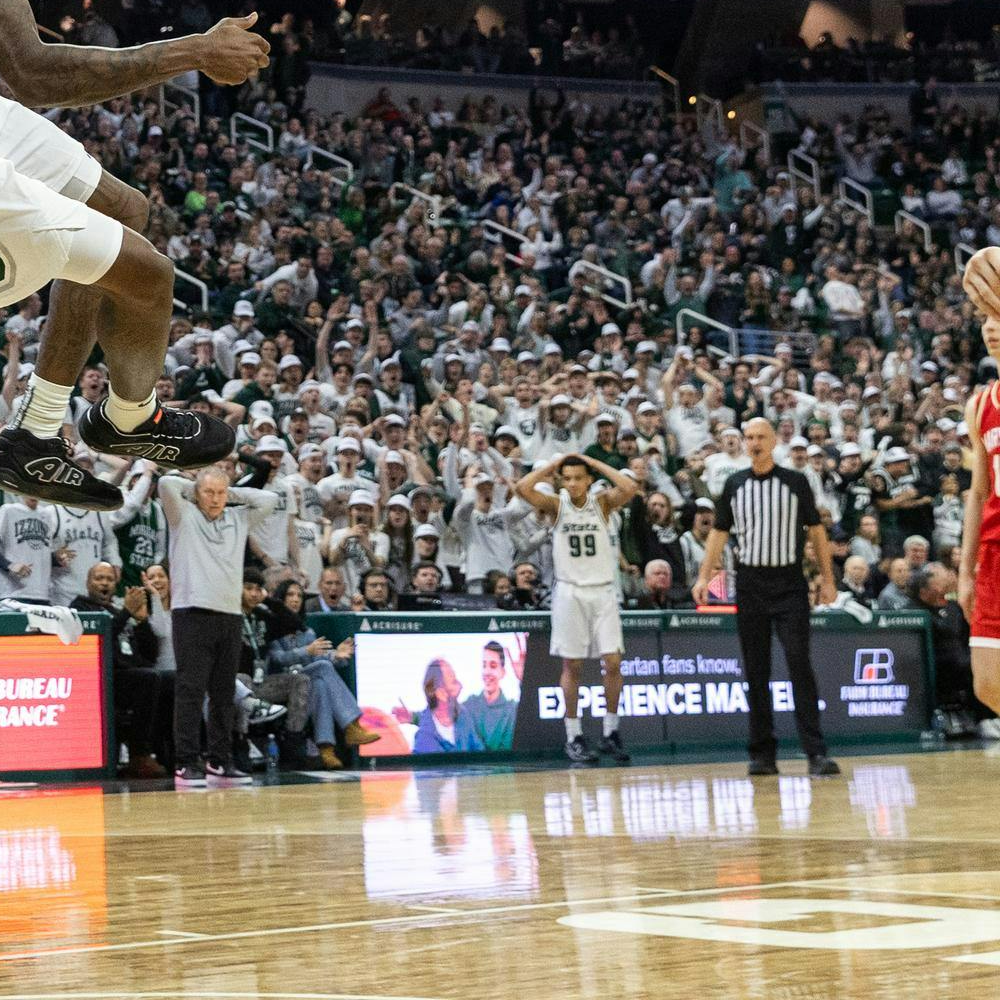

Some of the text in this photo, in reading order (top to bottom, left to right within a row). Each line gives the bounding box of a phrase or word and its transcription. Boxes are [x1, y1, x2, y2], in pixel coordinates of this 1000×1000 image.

[24, 457, 84, 486] AIR
[568, 533, 597, 558] 99
[662, 655, 697, 675] fans
[697, 654, 742, 677] know,
[538, 682, 702, 720] EXPEIENCE
